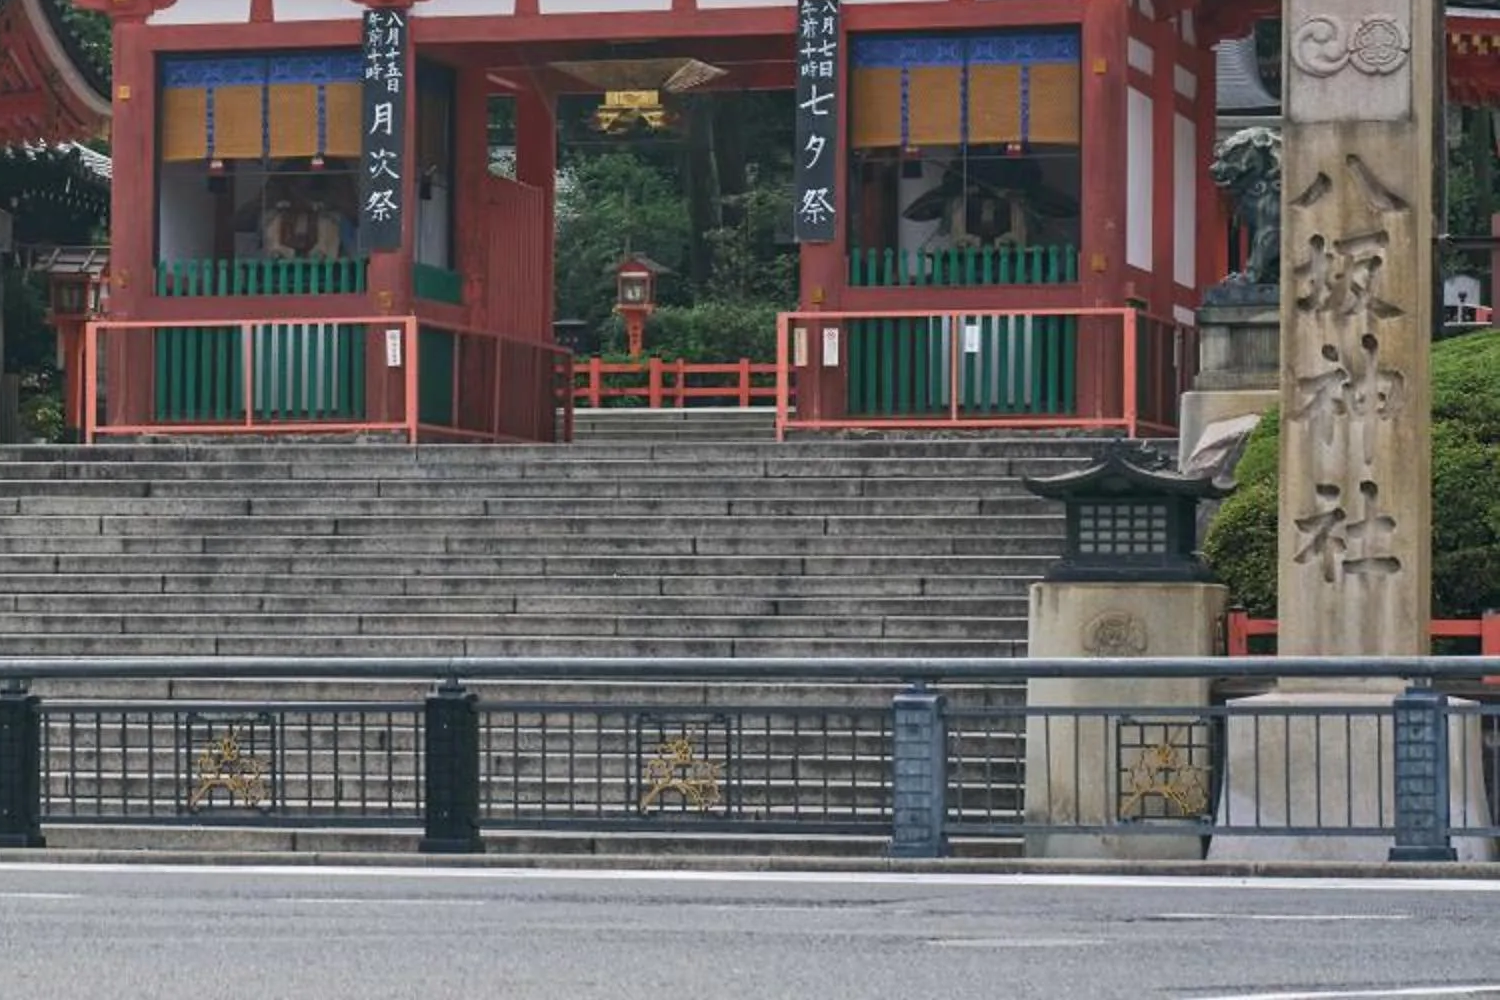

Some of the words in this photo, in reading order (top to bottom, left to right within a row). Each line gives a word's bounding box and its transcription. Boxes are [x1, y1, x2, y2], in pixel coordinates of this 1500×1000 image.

[384, 11, 405, 93] 八月十五日
[818, 0, 837, 77] 八月七日
[364, 102, 400, 222] 月次祭
[800, 84, 836, 224] 七夕祭
[1289, 153, 1409, 582] 八坂神社
